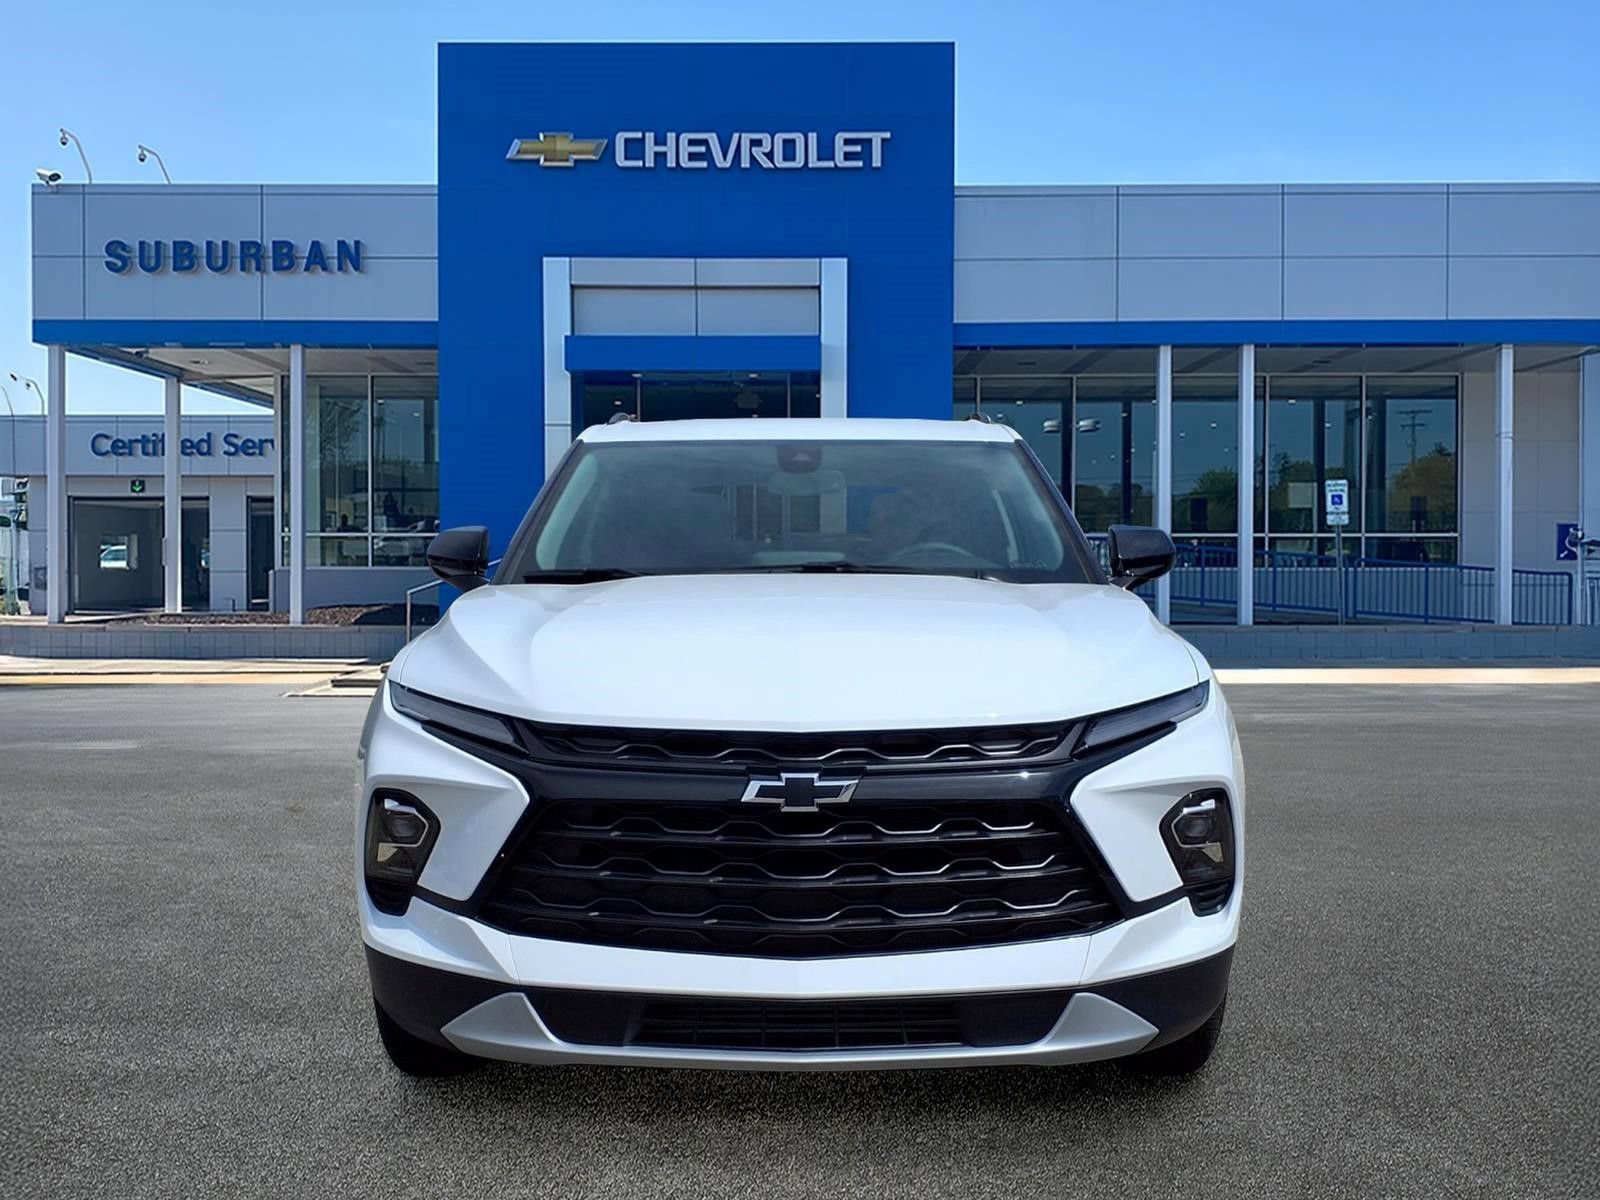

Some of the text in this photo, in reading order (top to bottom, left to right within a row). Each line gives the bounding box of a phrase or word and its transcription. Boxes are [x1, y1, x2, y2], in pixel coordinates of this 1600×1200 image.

[614, 131, 892, 169] CHEVROLET
[104, 240, 362, 273] SUBURBAN
[91, 432, 212, 456] Certifed
